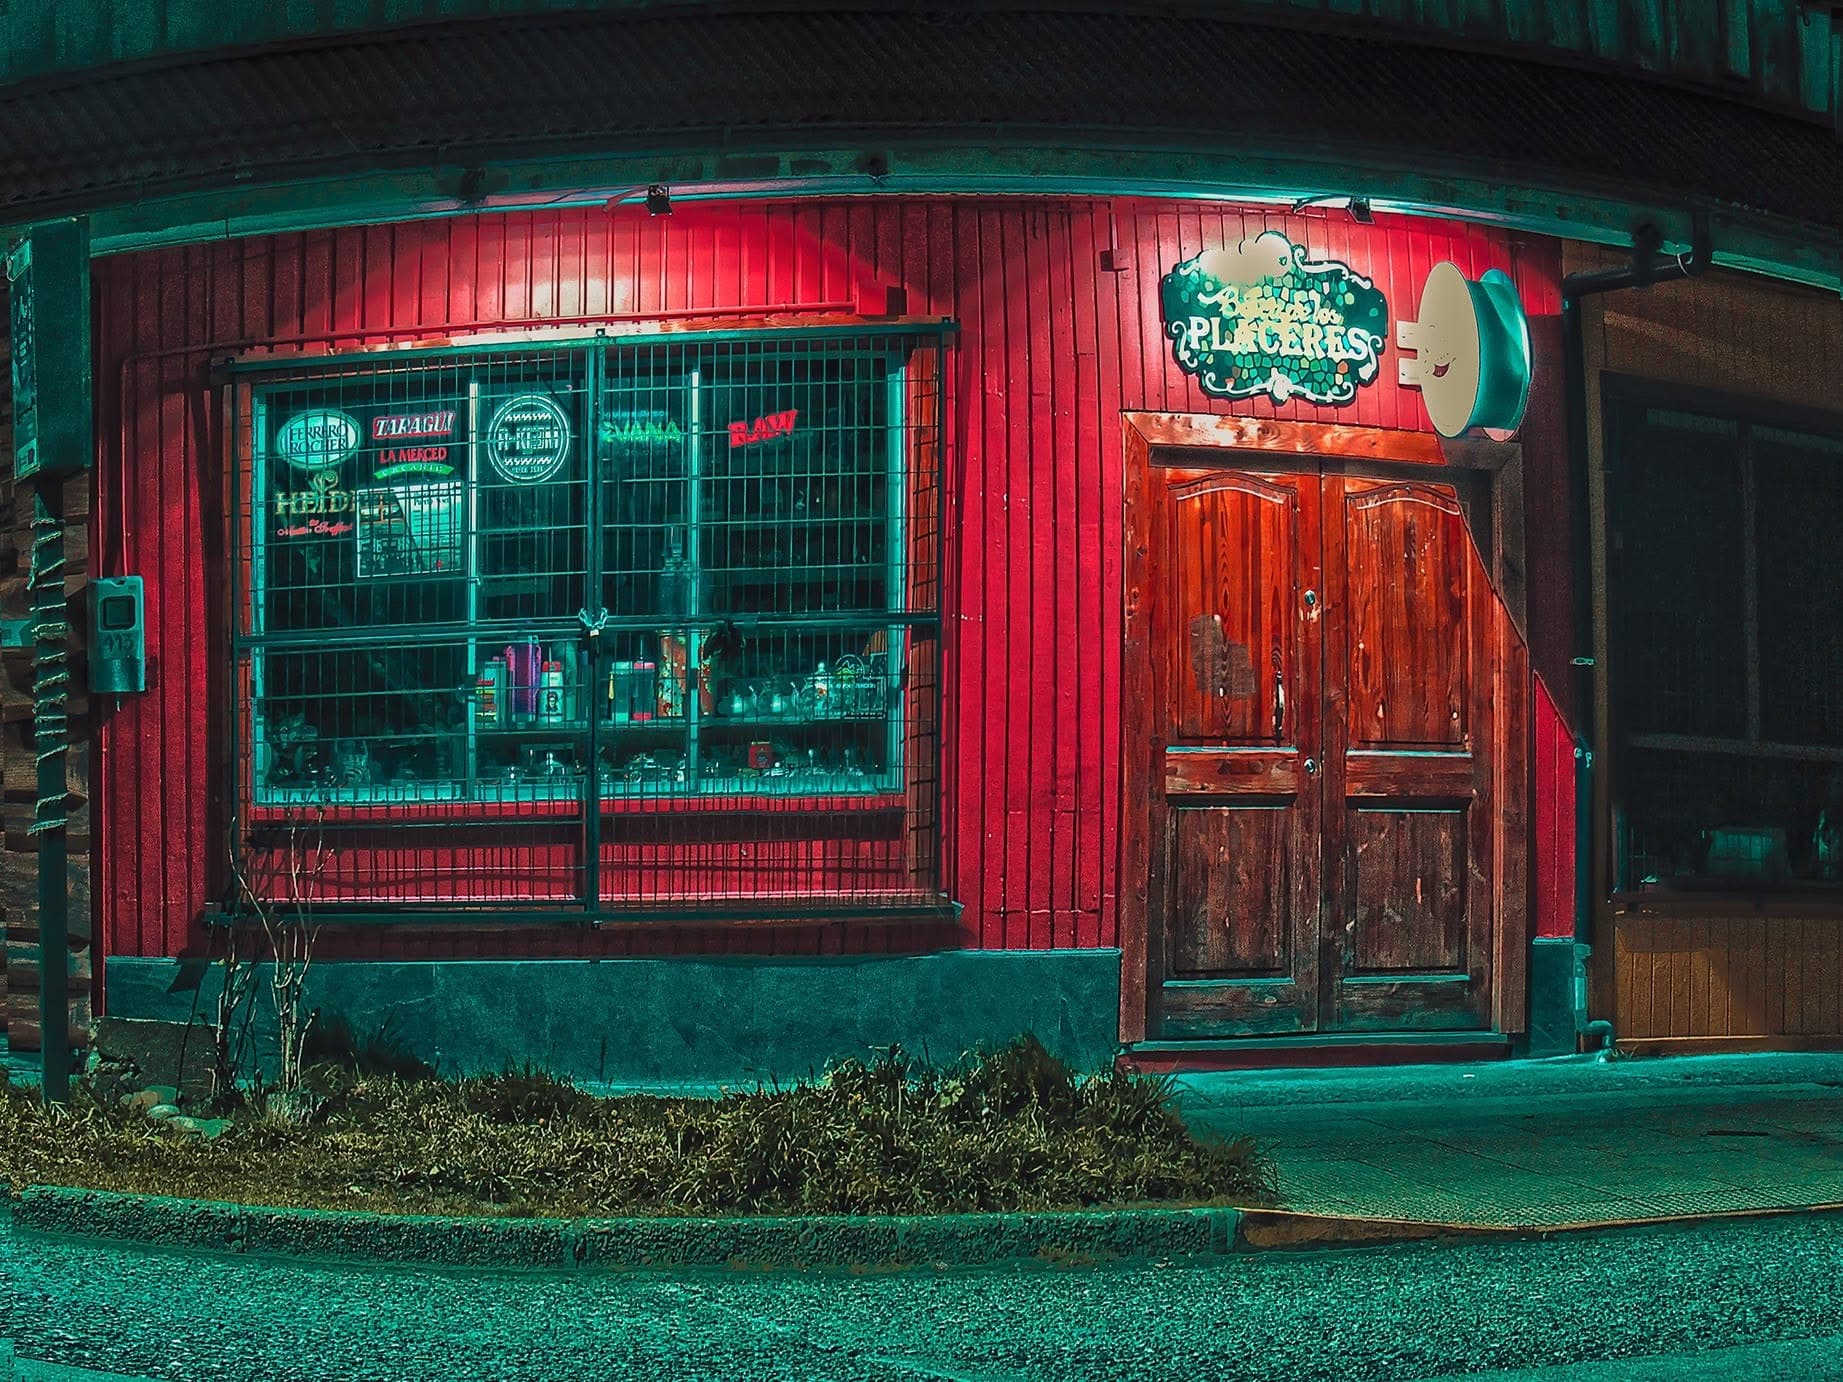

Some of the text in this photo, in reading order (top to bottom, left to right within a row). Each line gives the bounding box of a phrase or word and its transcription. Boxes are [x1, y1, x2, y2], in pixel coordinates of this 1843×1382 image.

[1308, 288, 1342, 325] los
[1188, 316, 1370, 361] PLACERES
[727, 409, 799, 448] RAW
[380, 447, 447, 464] LA MERCED
